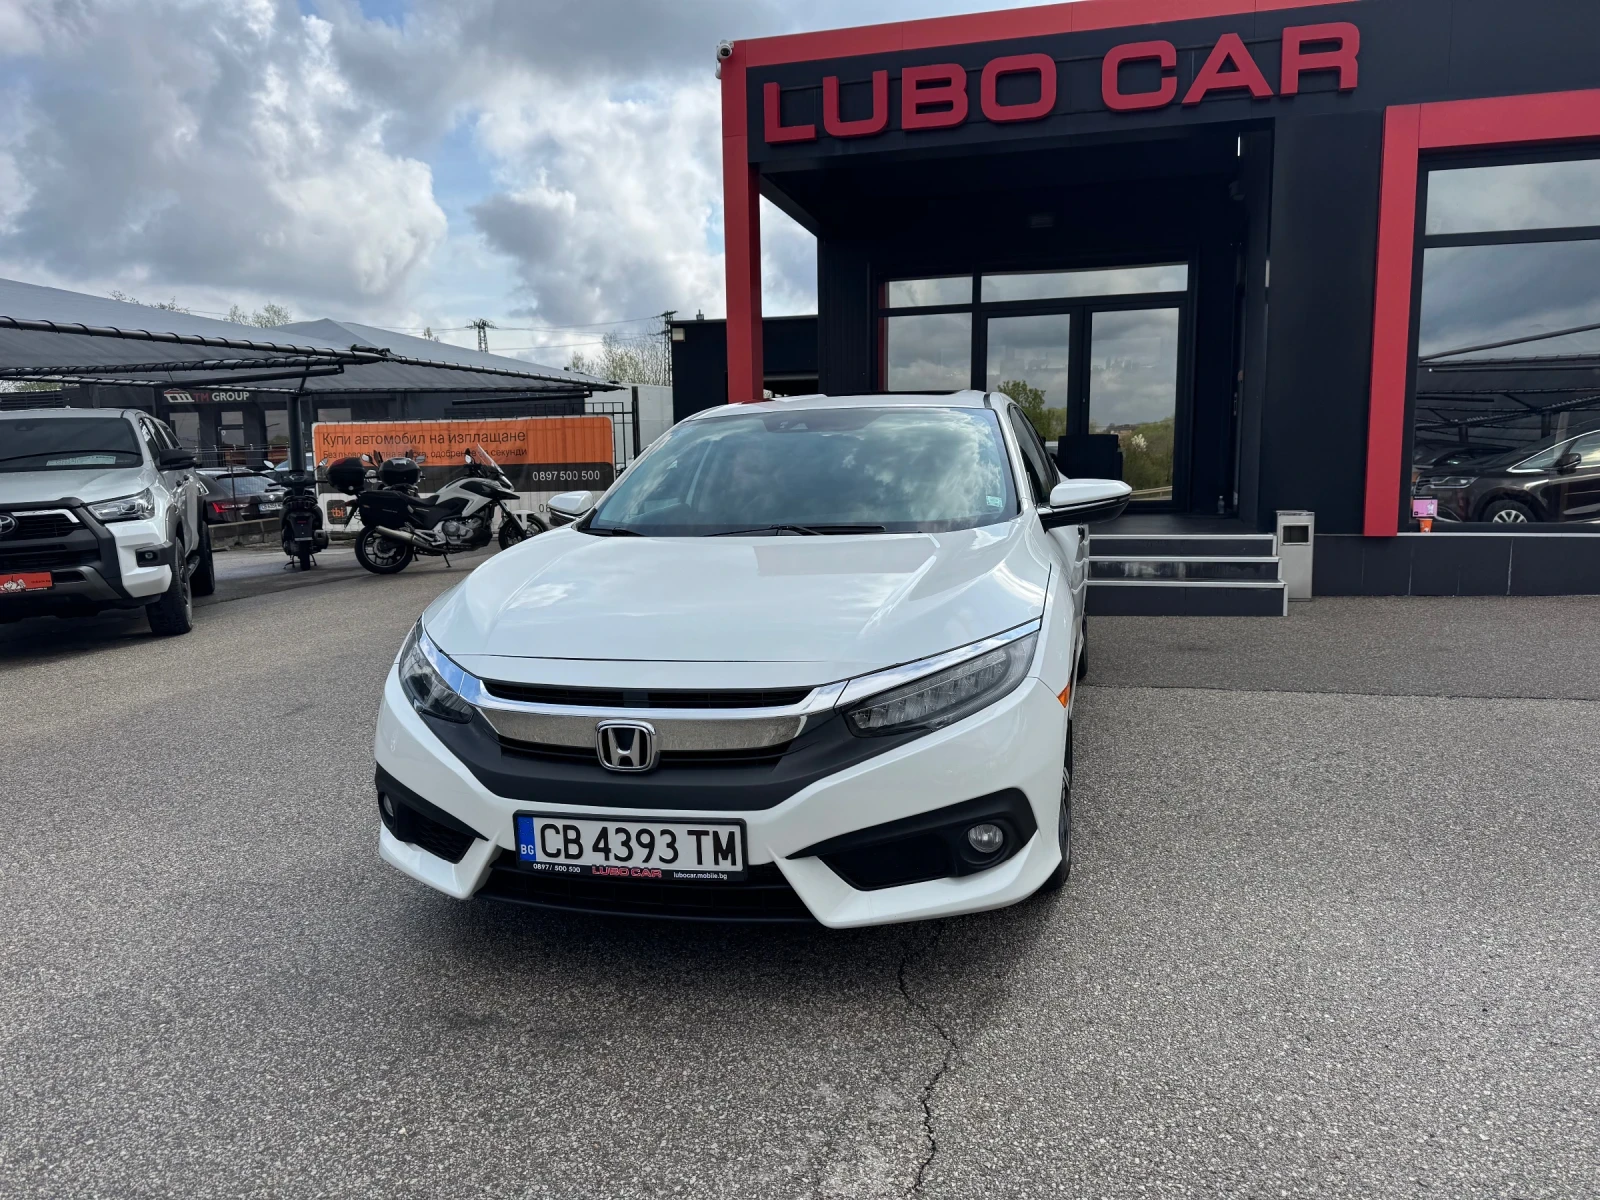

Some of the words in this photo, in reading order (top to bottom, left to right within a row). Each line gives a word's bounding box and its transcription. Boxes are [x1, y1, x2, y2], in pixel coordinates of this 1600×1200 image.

[764, 52, 1057, 145] LUBO
[1101, 21, 1360, 112] CAR
[193, 392, 210, 402] TM
[211, 391, 250, 401] GROUP
[322, 433, 351, 447] Купи
[355, 432, 425, 445] автомобил
[429, 434, 445, 444] на
[448, 431, 526, 445] изплащане
[323, 450, 337, 459] Без
[430, 448, 477, 459] одобрене
[490, 447, 527, 458] секунди
[532, 471, 558, 481] 0897
[560, 471, 579, 480] 500
[581, 470, 600, 480] 500
[331, 507, 345, 517] tbi
[520, 844, 535, 855] BG
[540, 823, 584, 860] CB
[592, 826, 679, 865] 4393
[686, 829, 737, 867] TM
[591, 865, 630, 877] LUBO
[630, 867, 663, 878] CAR
[673, 871, 728, 880] lubocar.mobile.bg
